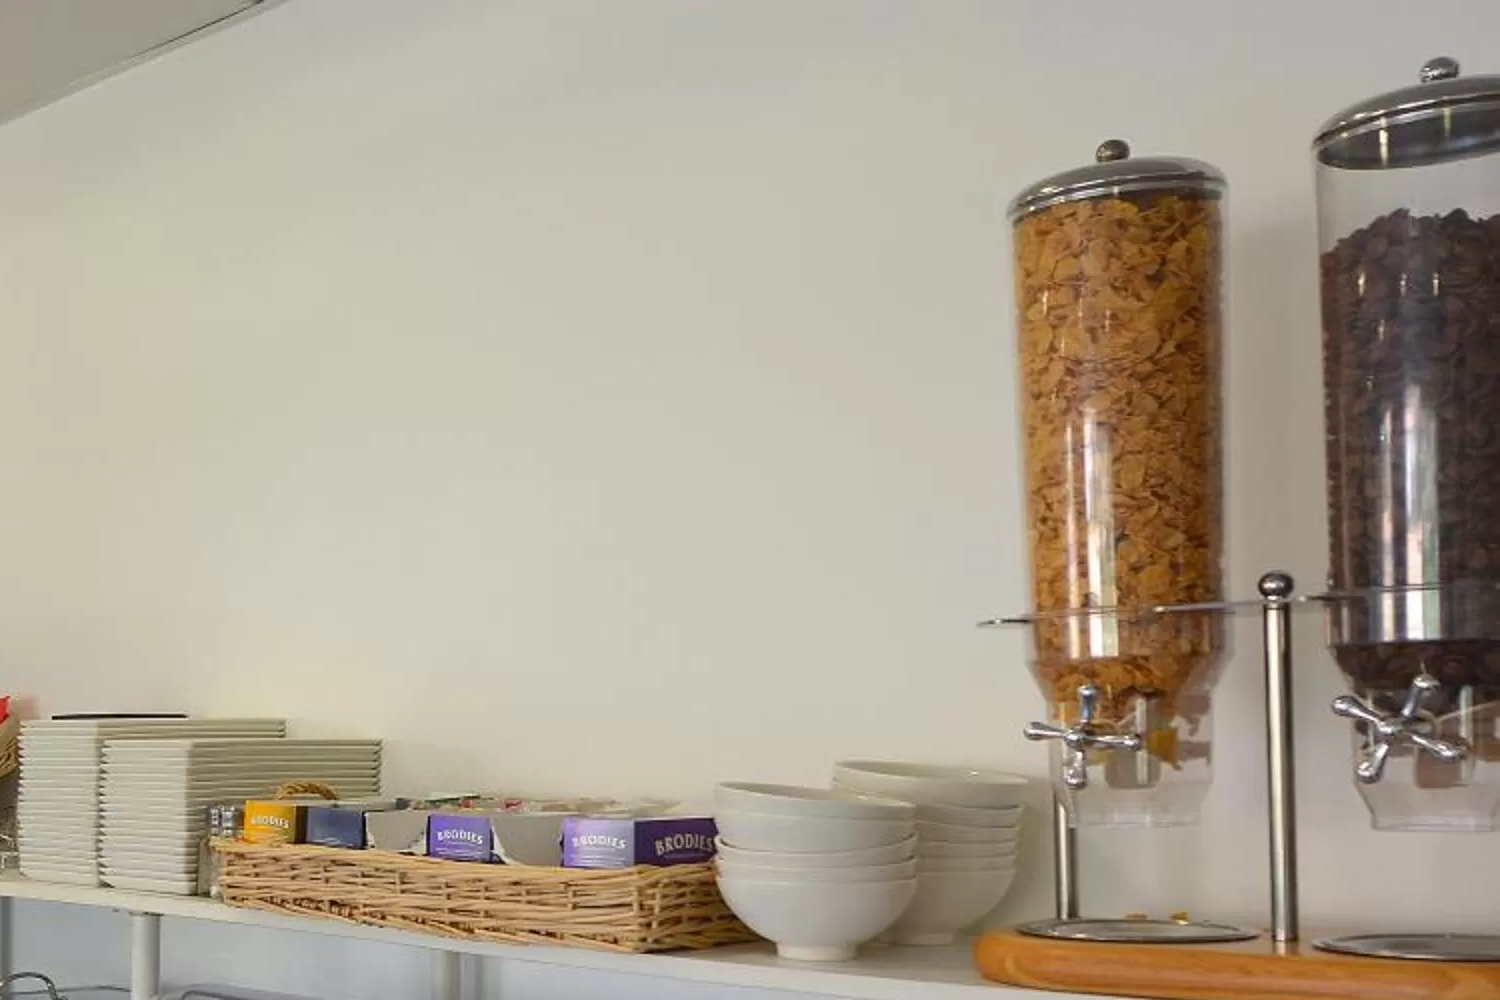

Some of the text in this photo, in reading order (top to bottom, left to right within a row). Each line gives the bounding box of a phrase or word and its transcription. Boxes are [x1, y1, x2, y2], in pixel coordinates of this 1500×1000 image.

[437, 828, 484, 845] BRODIES
[571, 833, 628, 850] BRODIES
[654, 832, 714, 857] BRODIES
